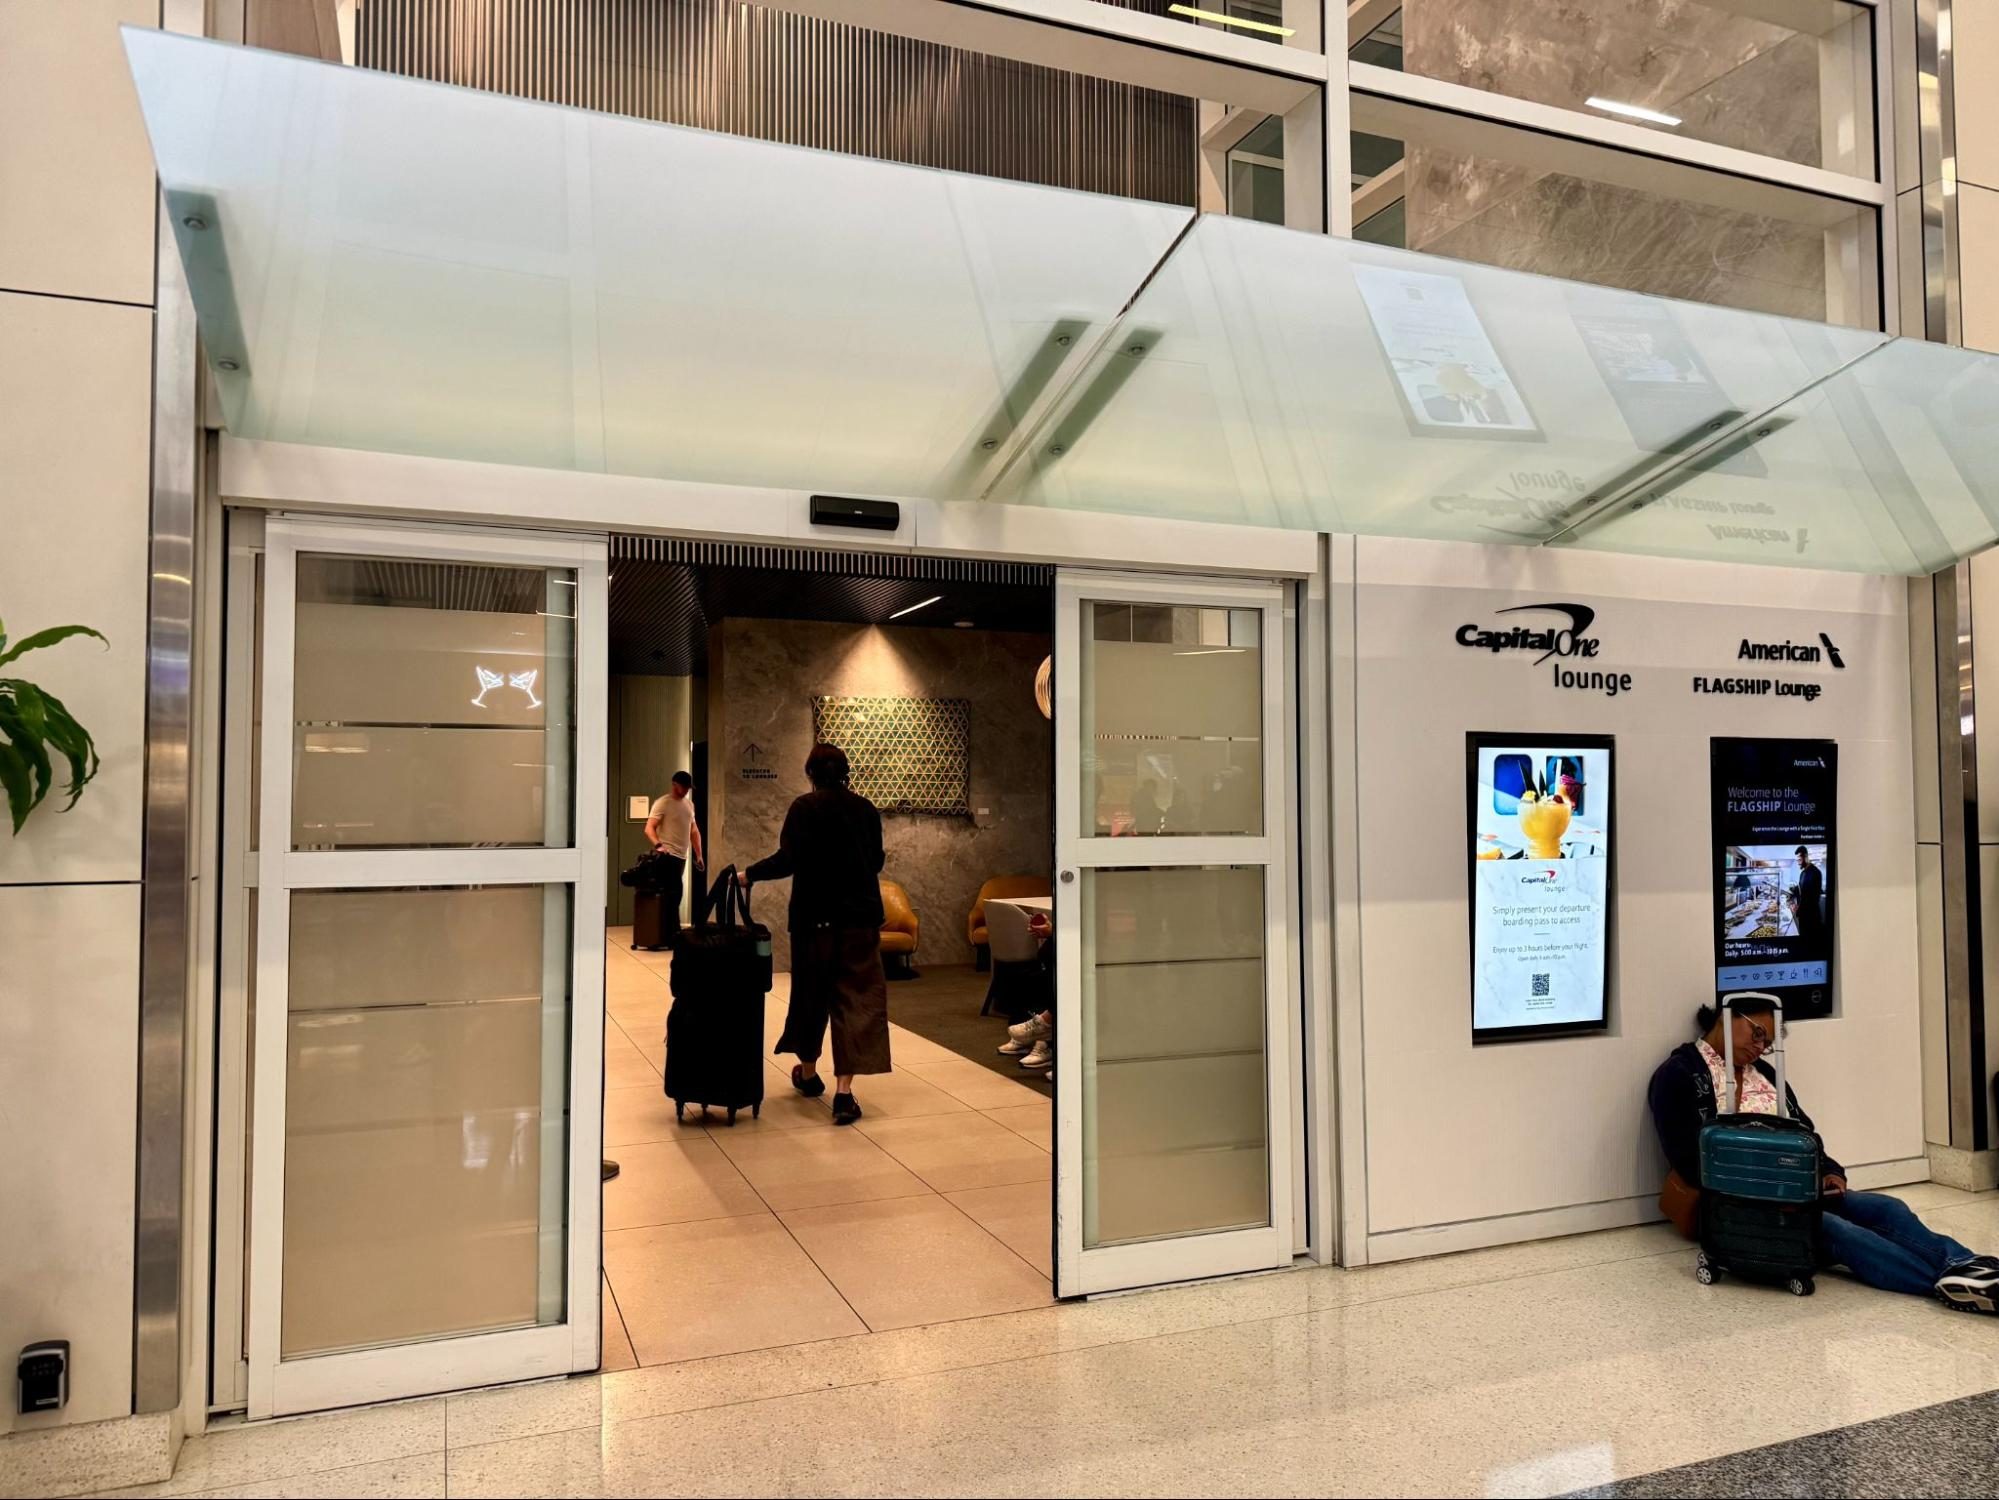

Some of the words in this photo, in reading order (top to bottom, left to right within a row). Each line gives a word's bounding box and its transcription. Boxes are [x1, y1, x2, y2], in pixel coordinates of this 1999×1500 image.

[1738, 639, 1821, 663] American
[1554, 664, 1632, 696] lounge
[1693, 677, 1771, 696] FLAGSHIP
[1775, 679, 1822, 701] Lounge
[1794, 759, 1818, 767] American
[1727, 786, 1771, 798] Welcome
[1772, 787, 1782, 798] to
[1784, 786, 1799, 798] the
[1727, 801, 1781, 812] FLAGSHIP
[1783, 801, 1816, 815] Lounge
[1492, 906, 1515, 916] Simply
[1517, 905, 1541, 915] present
[1543, 905, 1557, 916] your
[1559, 904, 1591, 914] departure
[1503, 917, 1533, 927] boarding
[1534, 918, 1549, 927] pass
[1551, 917, 1558, 925] to
[1559, 916, 1581, 925] access
